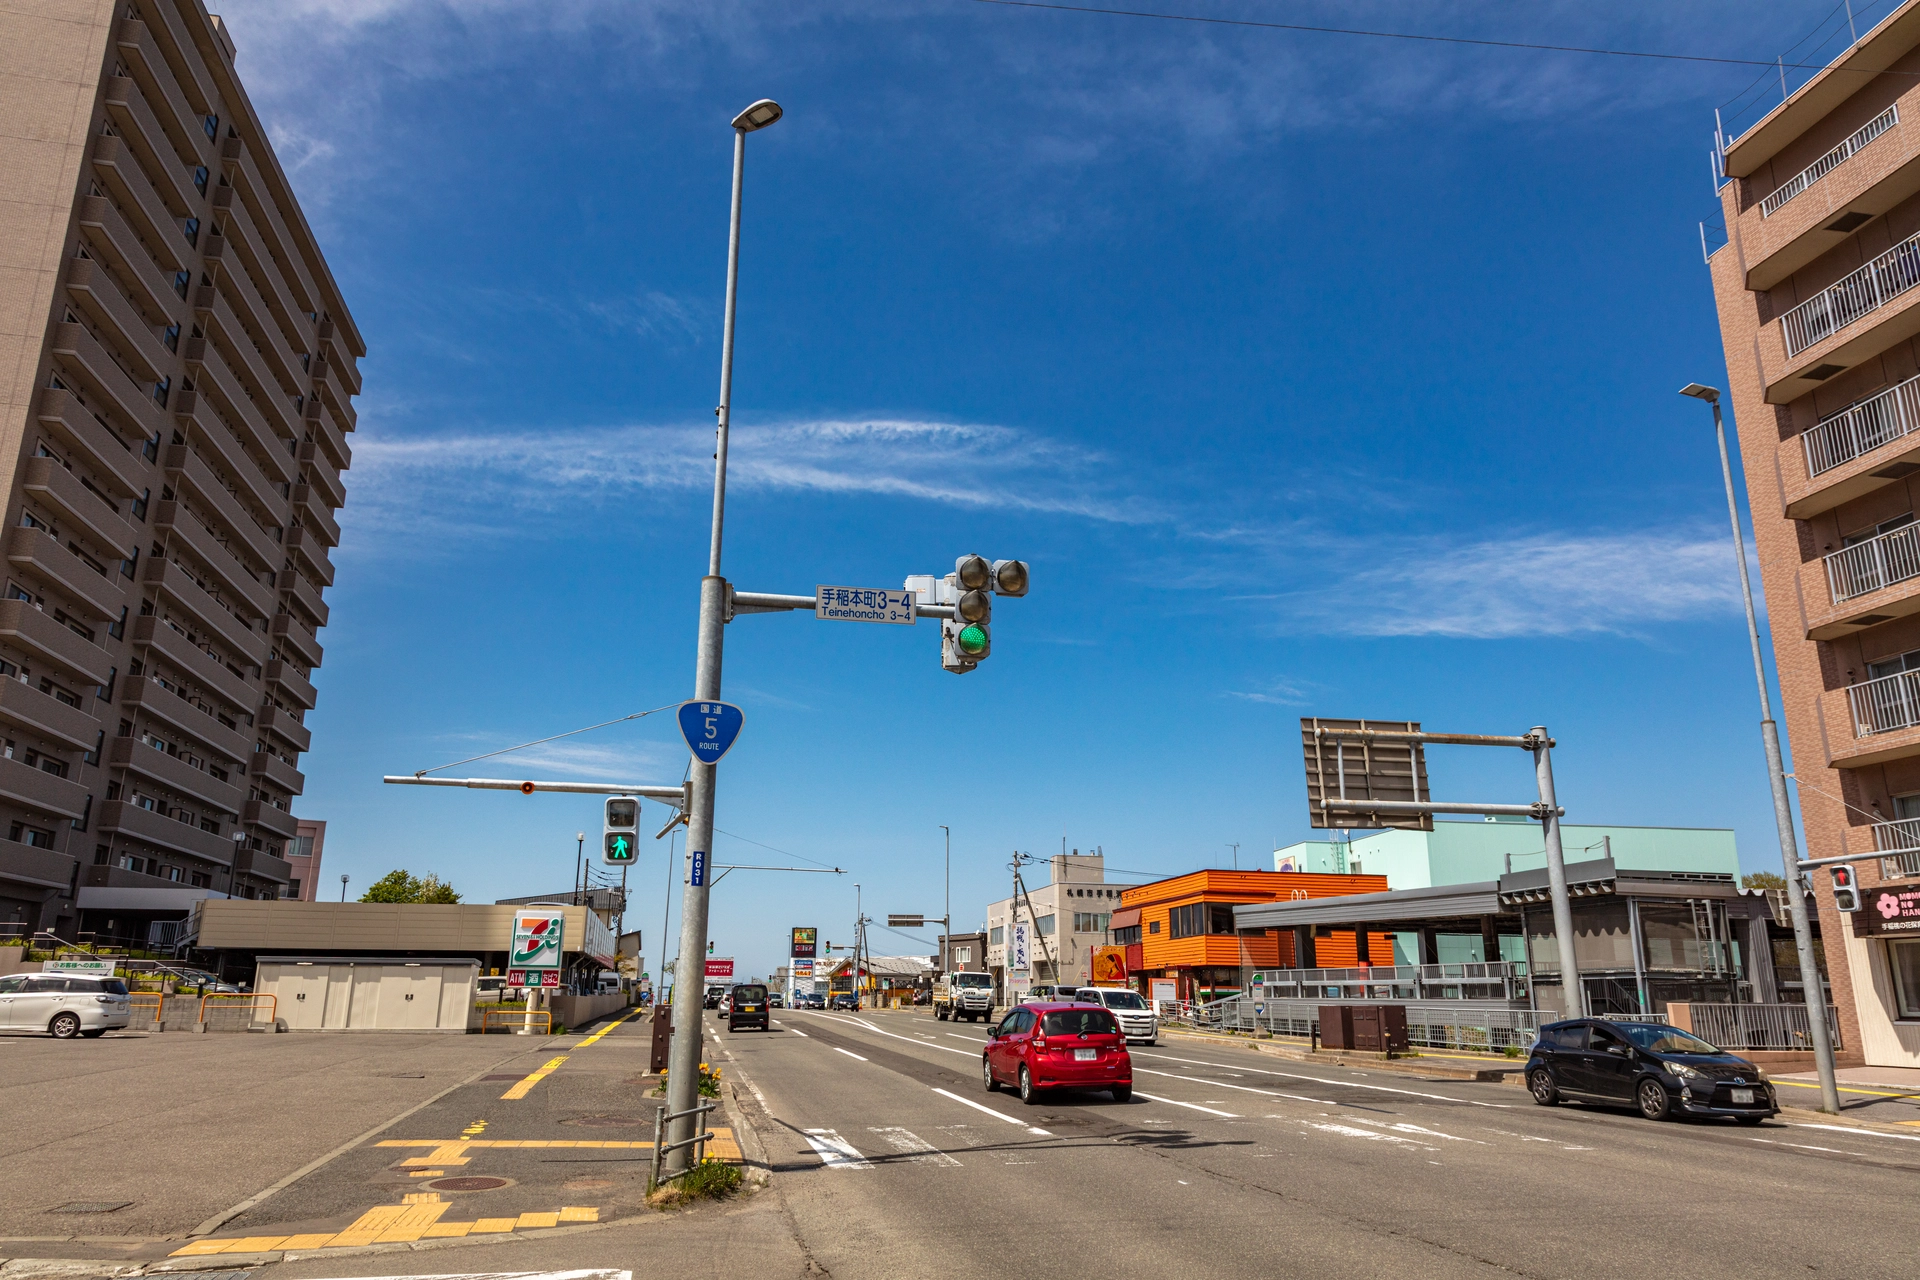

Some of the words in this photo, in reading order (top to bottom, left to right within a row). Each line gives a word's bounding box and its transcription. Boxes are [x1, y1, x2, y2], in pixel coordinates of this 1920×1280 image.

[822, 607, 885, 620] Teinehoncho
[890, 610, 911, 621] 3-4
[700, 704, 722, 714] 国道
[705, 717, 717, 739] 5
[699, 742, 719, 750] ROUTE
[1902, 908, 1920, 917] HAN
[509, 973, 525, 983] ATM
[528, 972, 539, 984] 酒
[543, 972, 558, 984] たばこ
